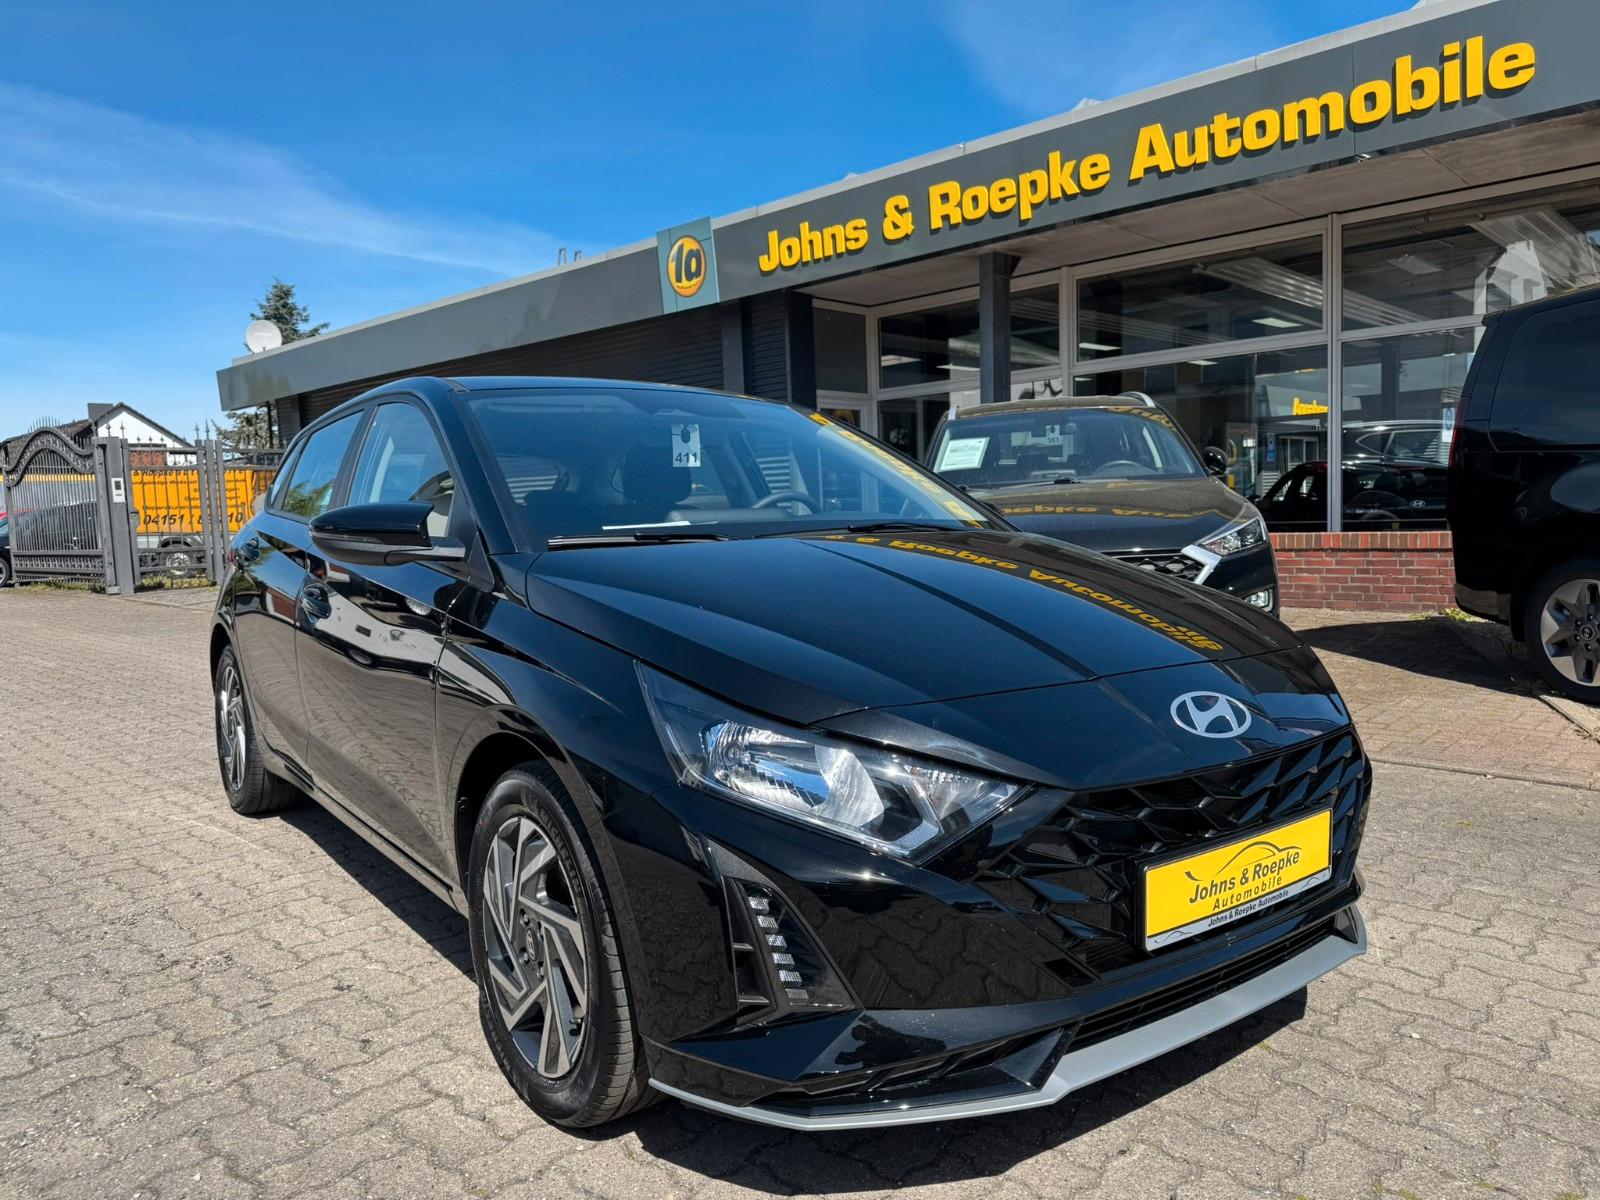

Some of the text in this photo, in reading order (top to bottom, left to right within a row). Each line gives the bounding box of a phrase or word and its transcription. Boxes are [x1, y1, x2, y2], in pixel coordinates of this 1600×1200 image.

[758, 35, 1536, 272] Johns & Roepke Automobile
[675, 452, 698, 463] 411
[143, 513, 184, 526] 04151
[1189, 850, 1301, 904] Johns & Roepke
[1212, 875, 1283, 912] Automobile
[1207, 888, 1290, 928] Johns & Roepke Automobile
